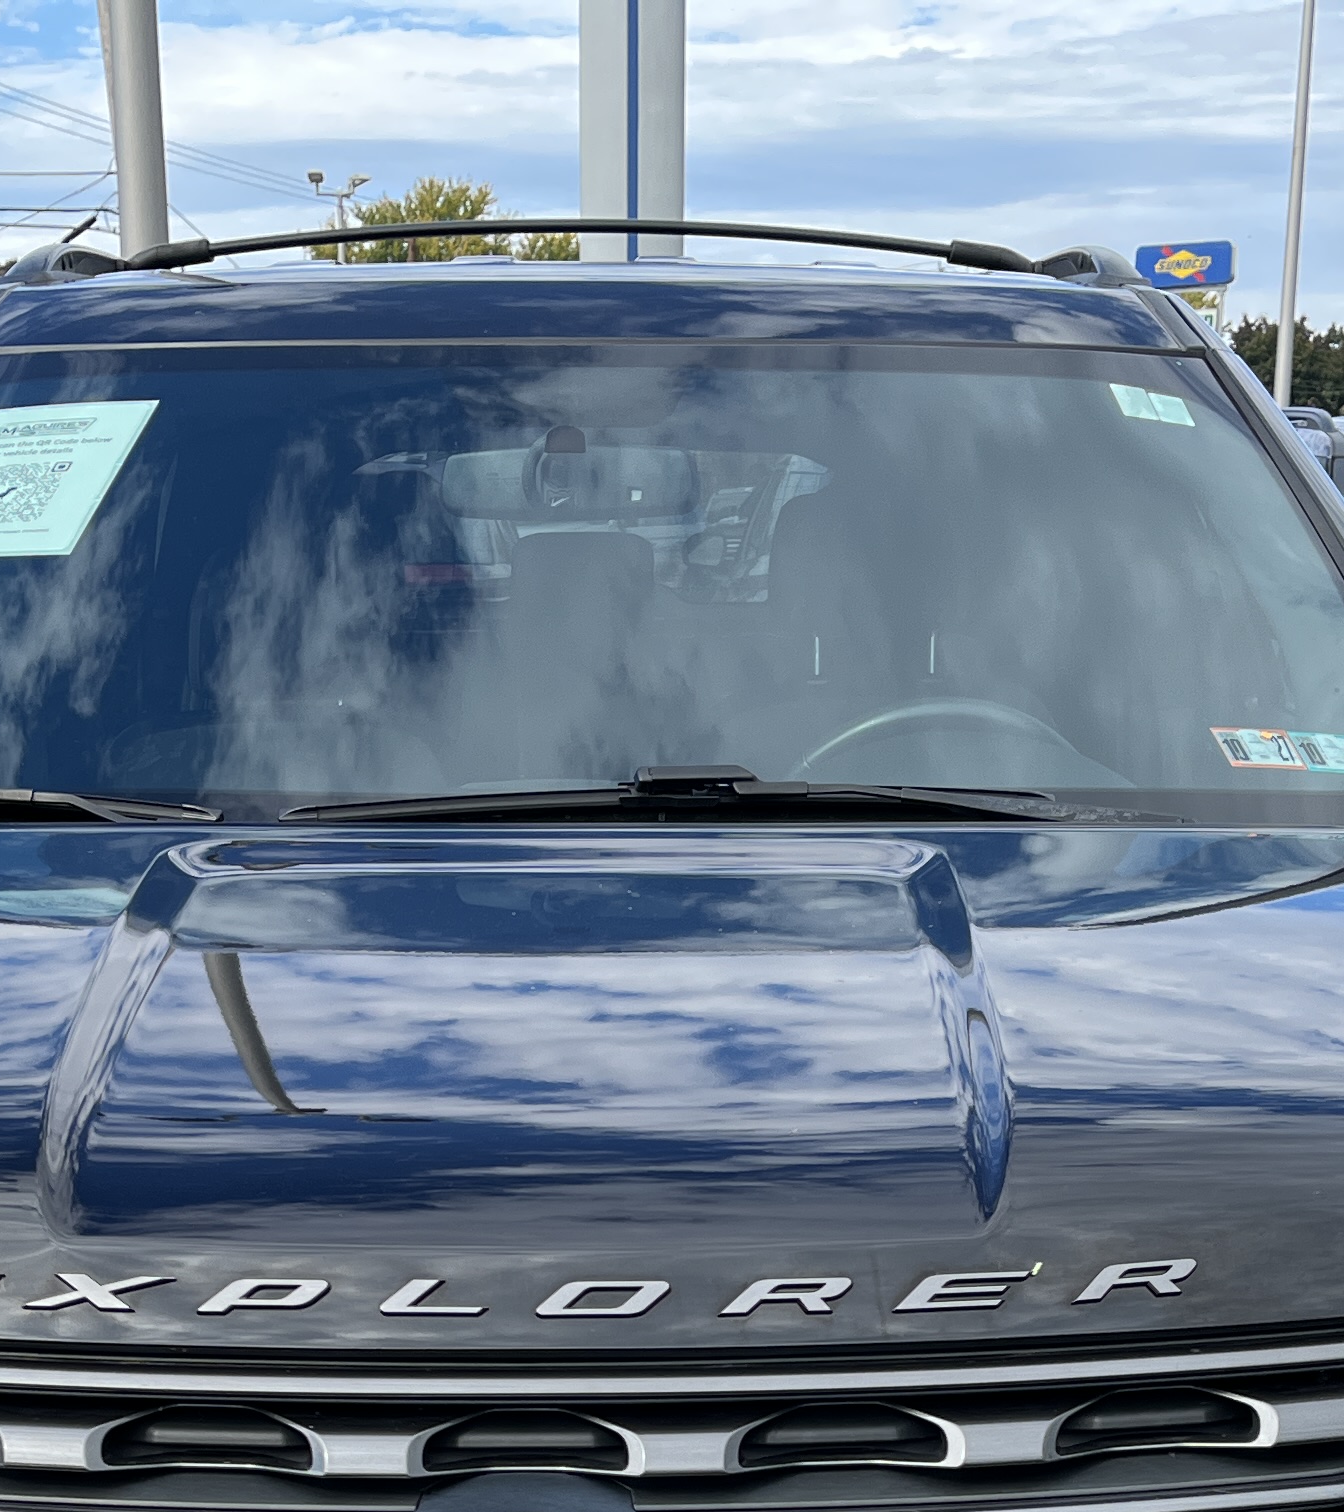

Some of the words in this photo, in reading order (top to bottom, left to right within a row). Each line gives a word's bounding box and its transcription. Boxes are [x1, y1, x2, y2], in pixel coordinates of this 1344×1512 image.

[1158, 257, 1209, 271] SUNOCO
[17, 440, 34, 448] the
[36, 439, 52, 447] QR
[54, 438, 79, 446] Code
[1270, 735, 1296, 764] 27
